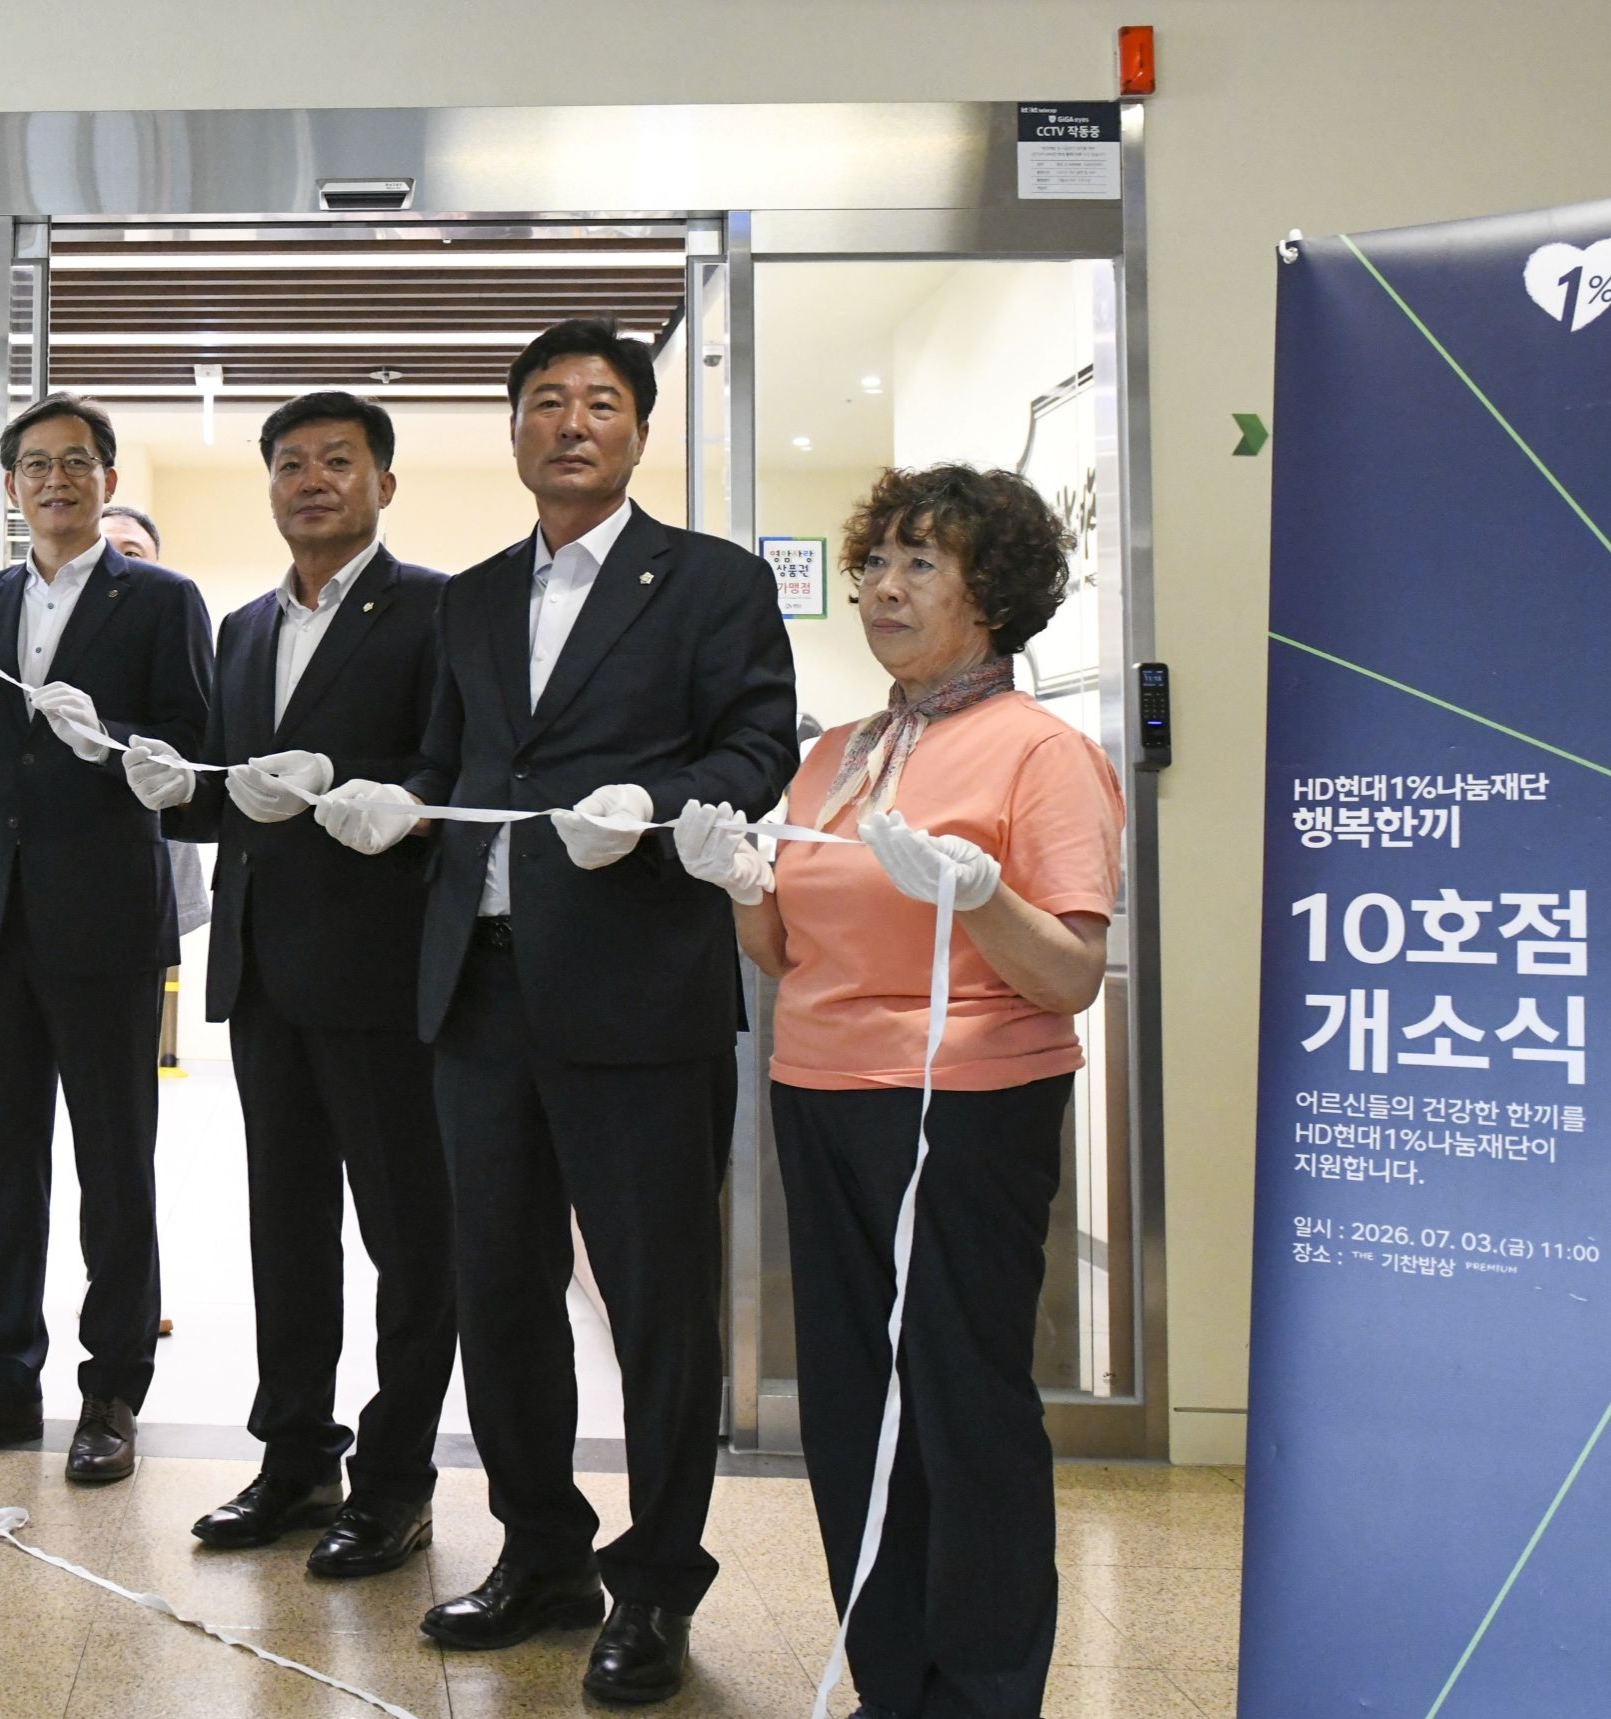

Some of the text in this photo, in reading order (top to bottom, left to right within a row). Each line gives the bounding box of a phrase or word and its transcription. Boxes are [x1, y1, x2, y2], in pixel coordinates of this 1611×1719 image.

[1036, 125, 1100, 139] CCTV 작동중
[1558, 265, 1611, 332] 1%
[777, 564, 810, 578] 상품권
[777, 582, 811, 594] 가맹점
[1294, 772, 1550, 802] HD현대1%나눔재단
[1292, 805, 1460, 849] 행복한끼
[1292, 888, 1588, 977] 10호점
[1301, 988, 1586, 1085] 개소식
[1296, 1090, 1586, 1133] 어르신들의 건강한 한끼를
[1295, 1122, 1557, 1163] HD현대1%나눔재단이
[1294, 1152, 1425, 1186] 지원합니다.
[1292, 1242, 1331, 1263] 장소
[1351, 1251, 1374, 1261] THE
[1381, 1253, 1456, 1278] 기찬밥상
[1465, 1261, 1518, 1273] PREMIUM
[1294, 1216, 1332, 1239] 일시
[1351, 1222, 1415, 1246] 2026.
[1420, 1228, 1455, 1250] 07.
[1461, 1232, 1534, 1259] 03.(금)
[1541, 1242, 1600, 1263] 11:00
